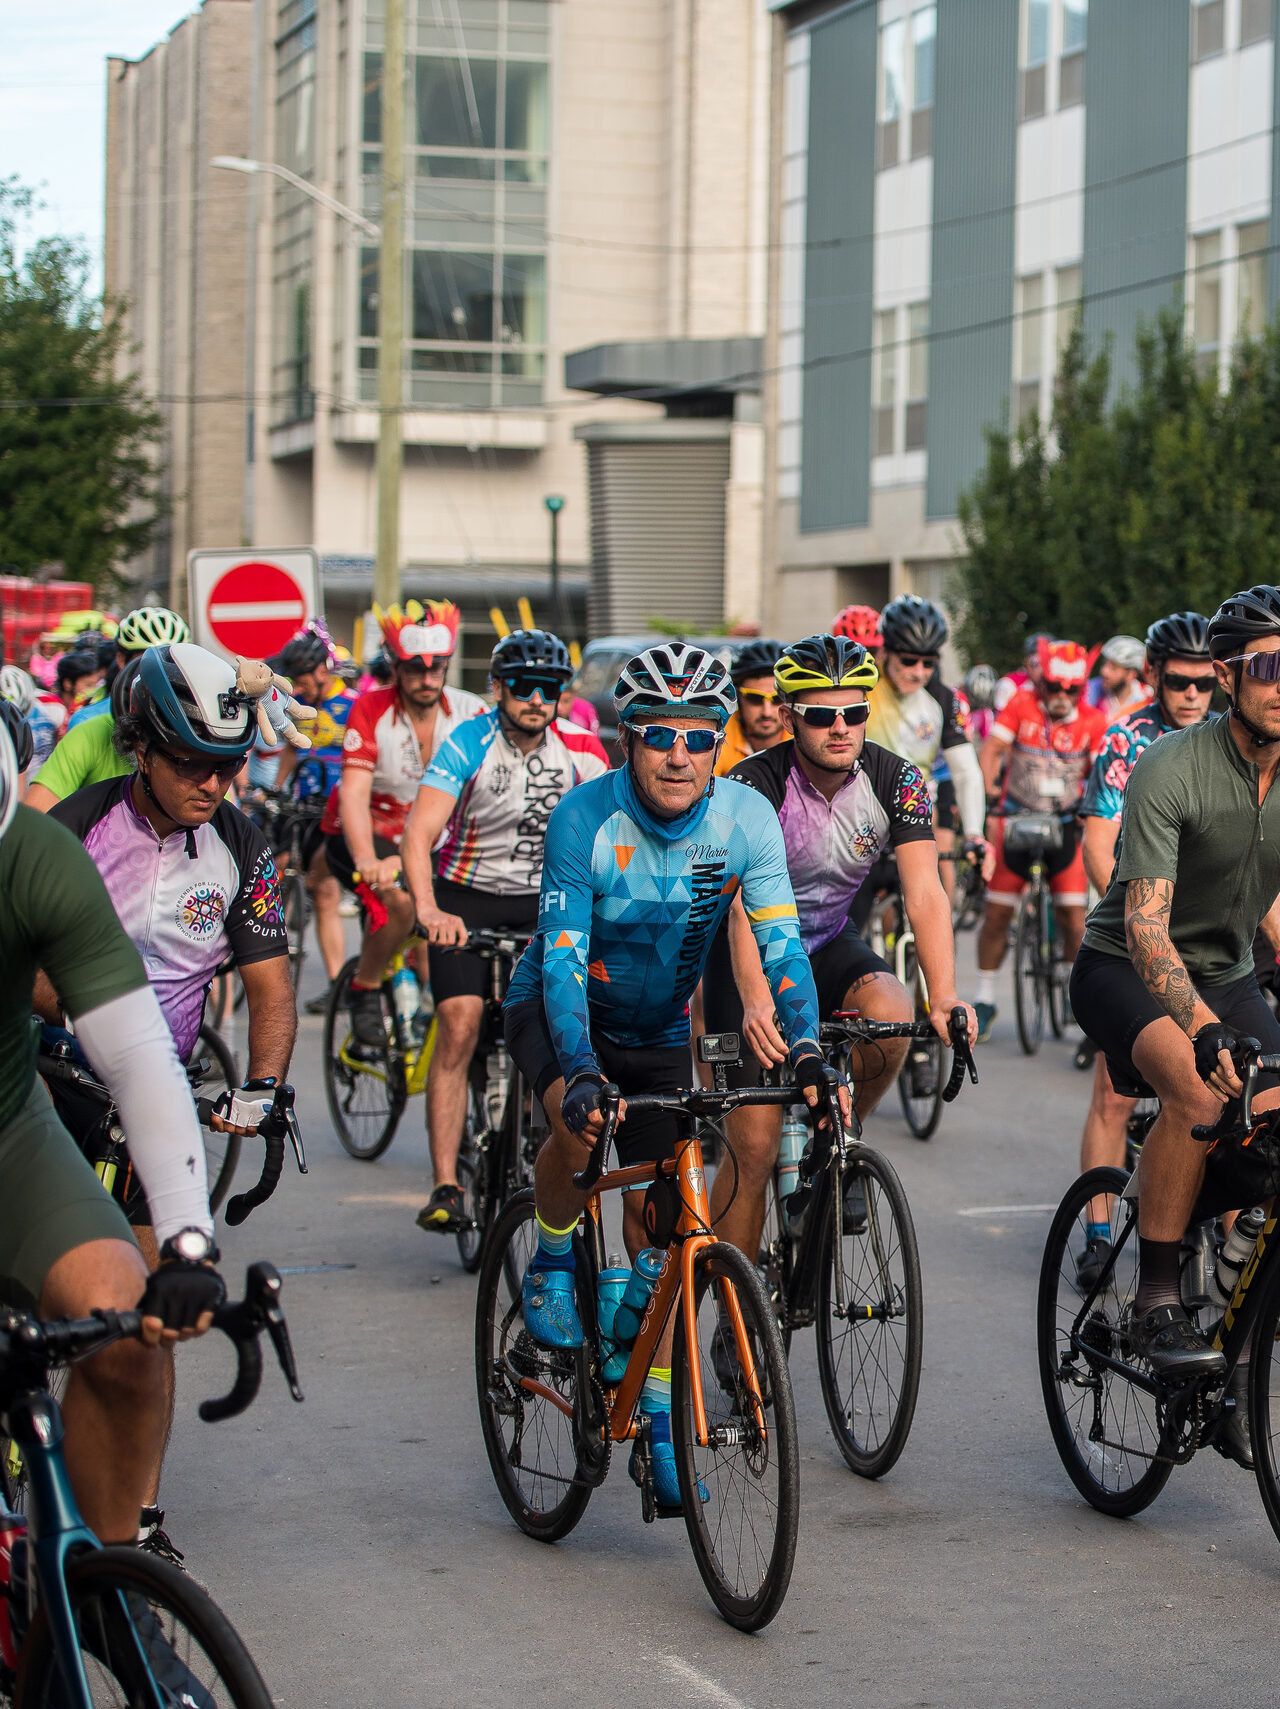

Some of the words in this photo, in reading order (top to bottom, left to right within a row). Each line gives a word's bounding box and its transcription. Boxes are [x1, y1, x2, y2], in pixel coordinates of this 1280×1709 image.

[685, 843, 729, 861] Marin
[176, 886, 194, 909] FRIENDS
[207, 881, 221, 889] LIFE
[244, 918, 278, 938] POUR
[672, 861, 726, 1004] MARAUDERS
